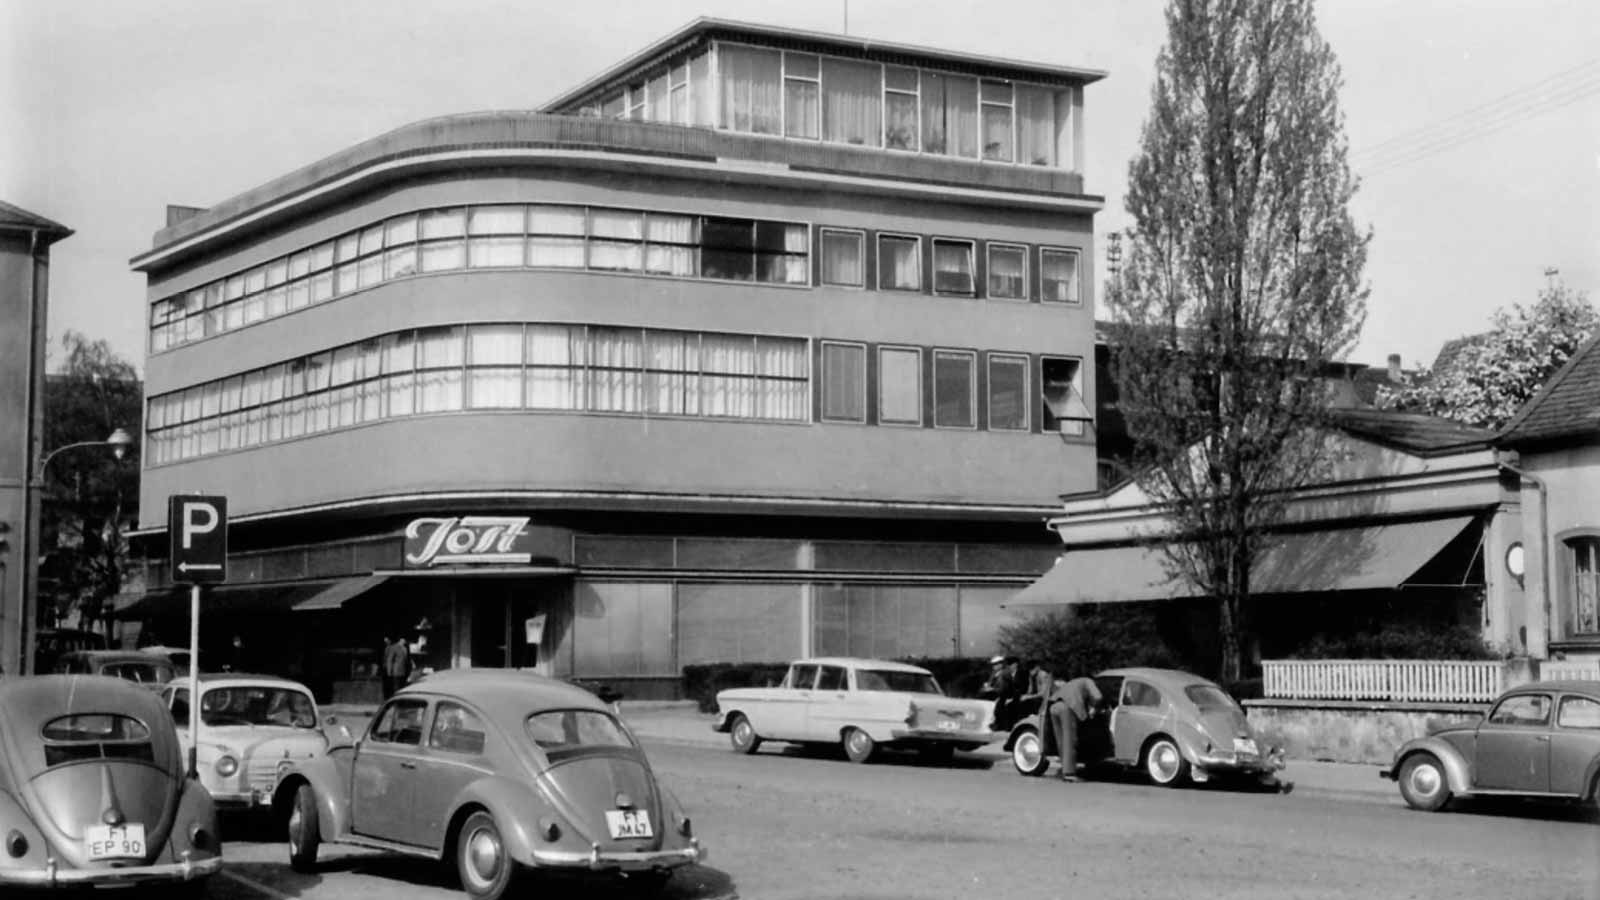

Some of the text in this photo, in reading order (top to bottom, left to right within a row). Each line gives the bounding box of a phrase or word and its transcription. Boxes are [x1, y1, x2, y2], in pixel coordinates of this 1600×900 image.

[183, 502, 218, 549] P
[406, 516, 531, 565] Jost
[92, 840, 141, 855] EP 90
